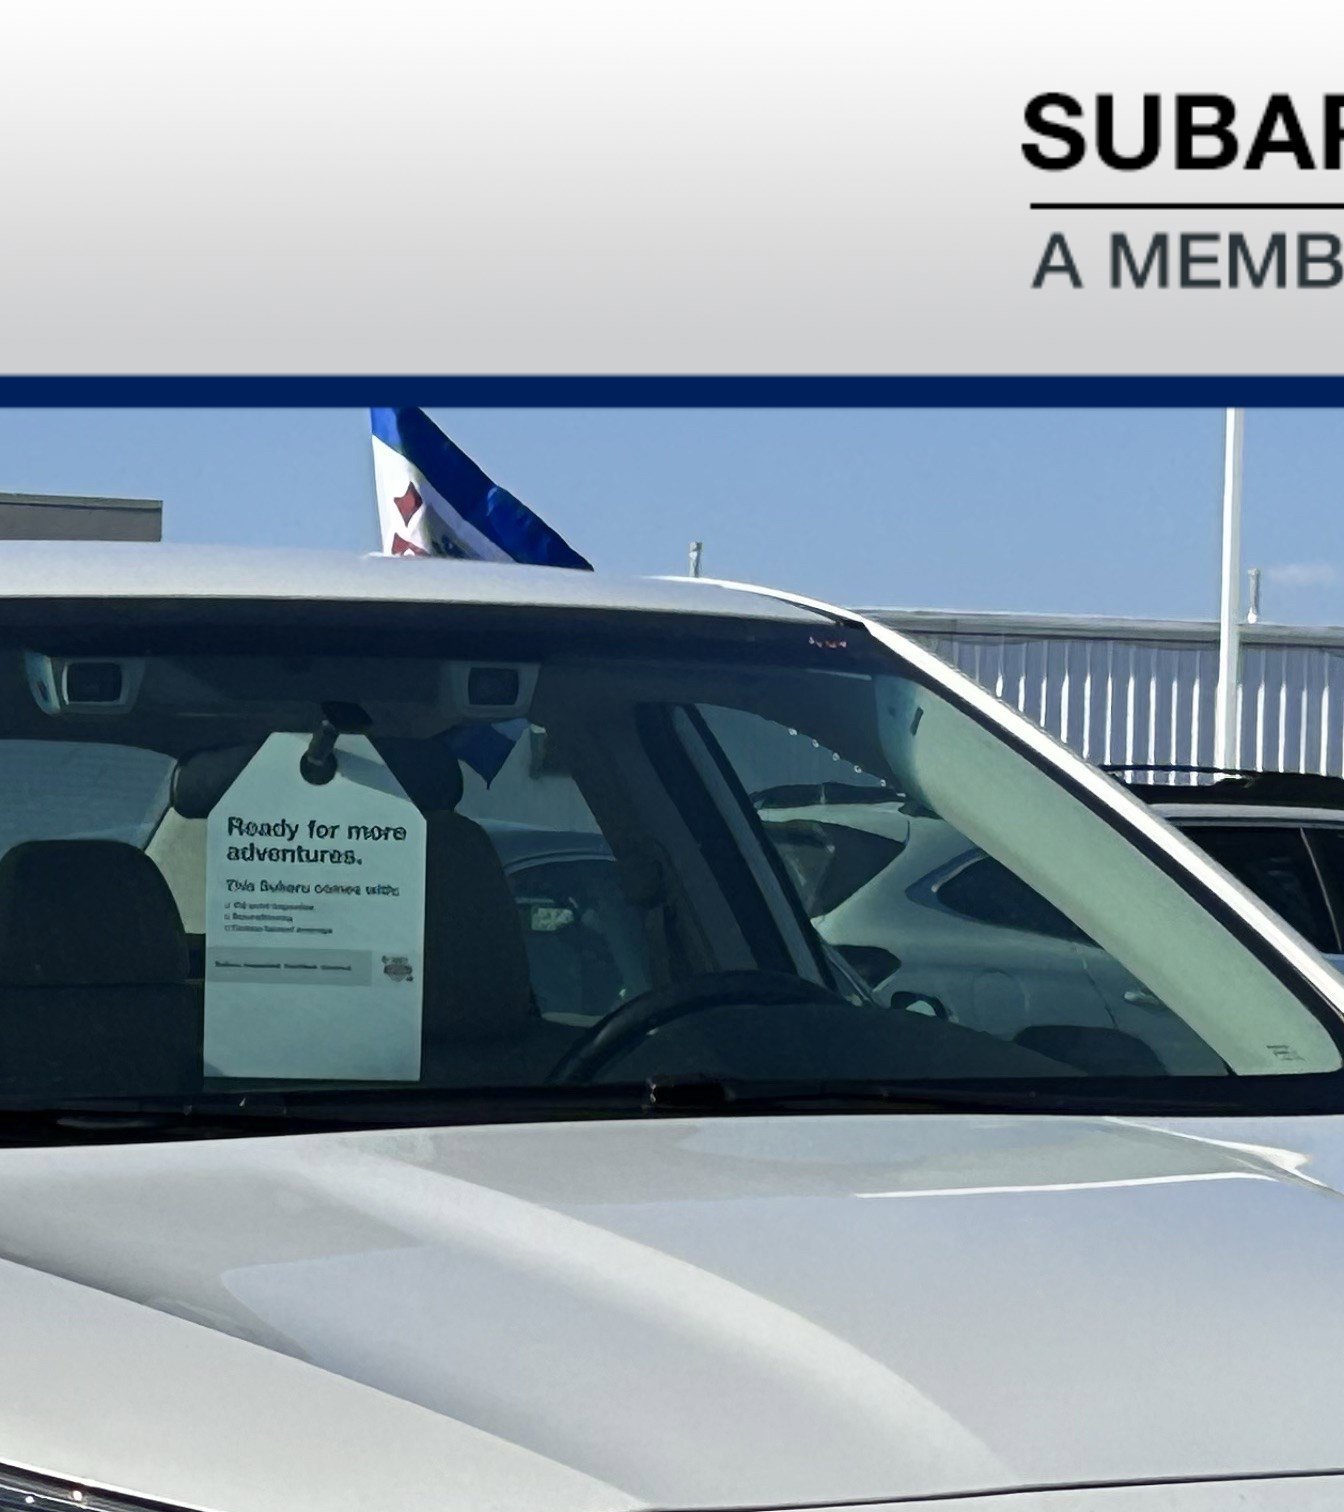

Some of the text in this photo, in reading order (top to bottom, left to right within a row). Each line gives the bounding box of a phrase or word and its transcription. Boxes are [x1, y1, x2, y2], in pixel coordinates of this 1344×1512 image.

[227, 816, 407, 841] Ready for more
[226, 842, 363, 865] adventures.
